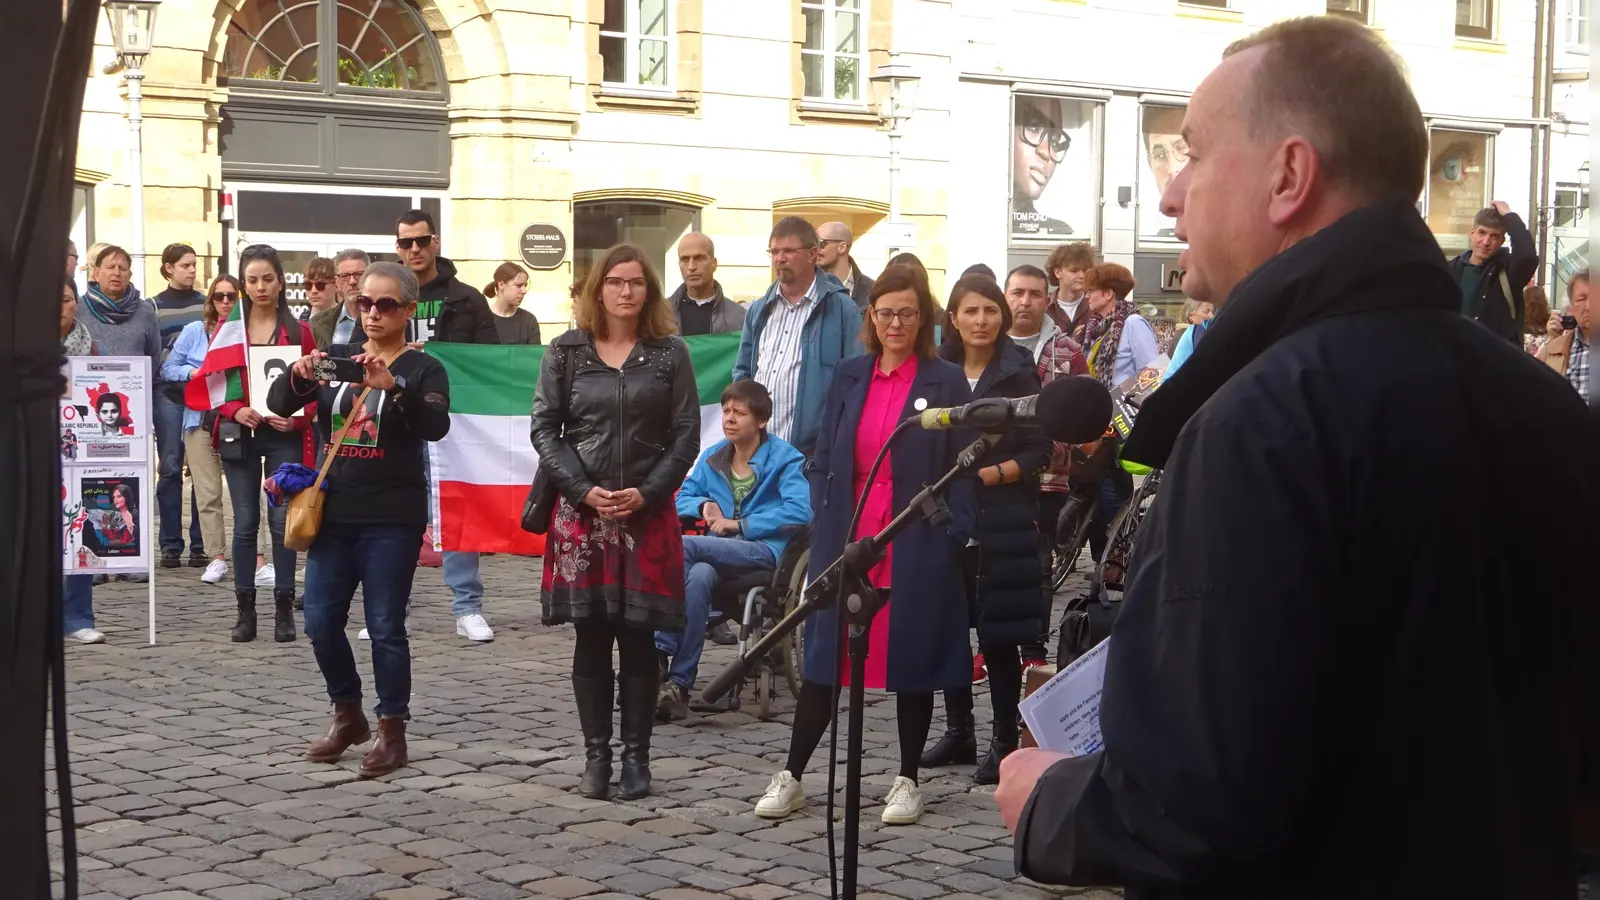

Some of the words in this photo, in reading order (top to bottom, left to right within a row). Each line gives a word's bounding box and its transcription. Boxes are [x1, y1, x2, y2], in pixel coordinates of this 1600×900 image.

[1012, 211, 1028, 222] TOM
[1029, 211, 1048, 222] FORD
[1114, 414, 1130, 435] Iran
[1068, 707, 1077, 715] und
[1075, 702, 1083, 710] die
[1081, 693, 1096, 706] Familie
[1080, 710, 1091, 719] dass
